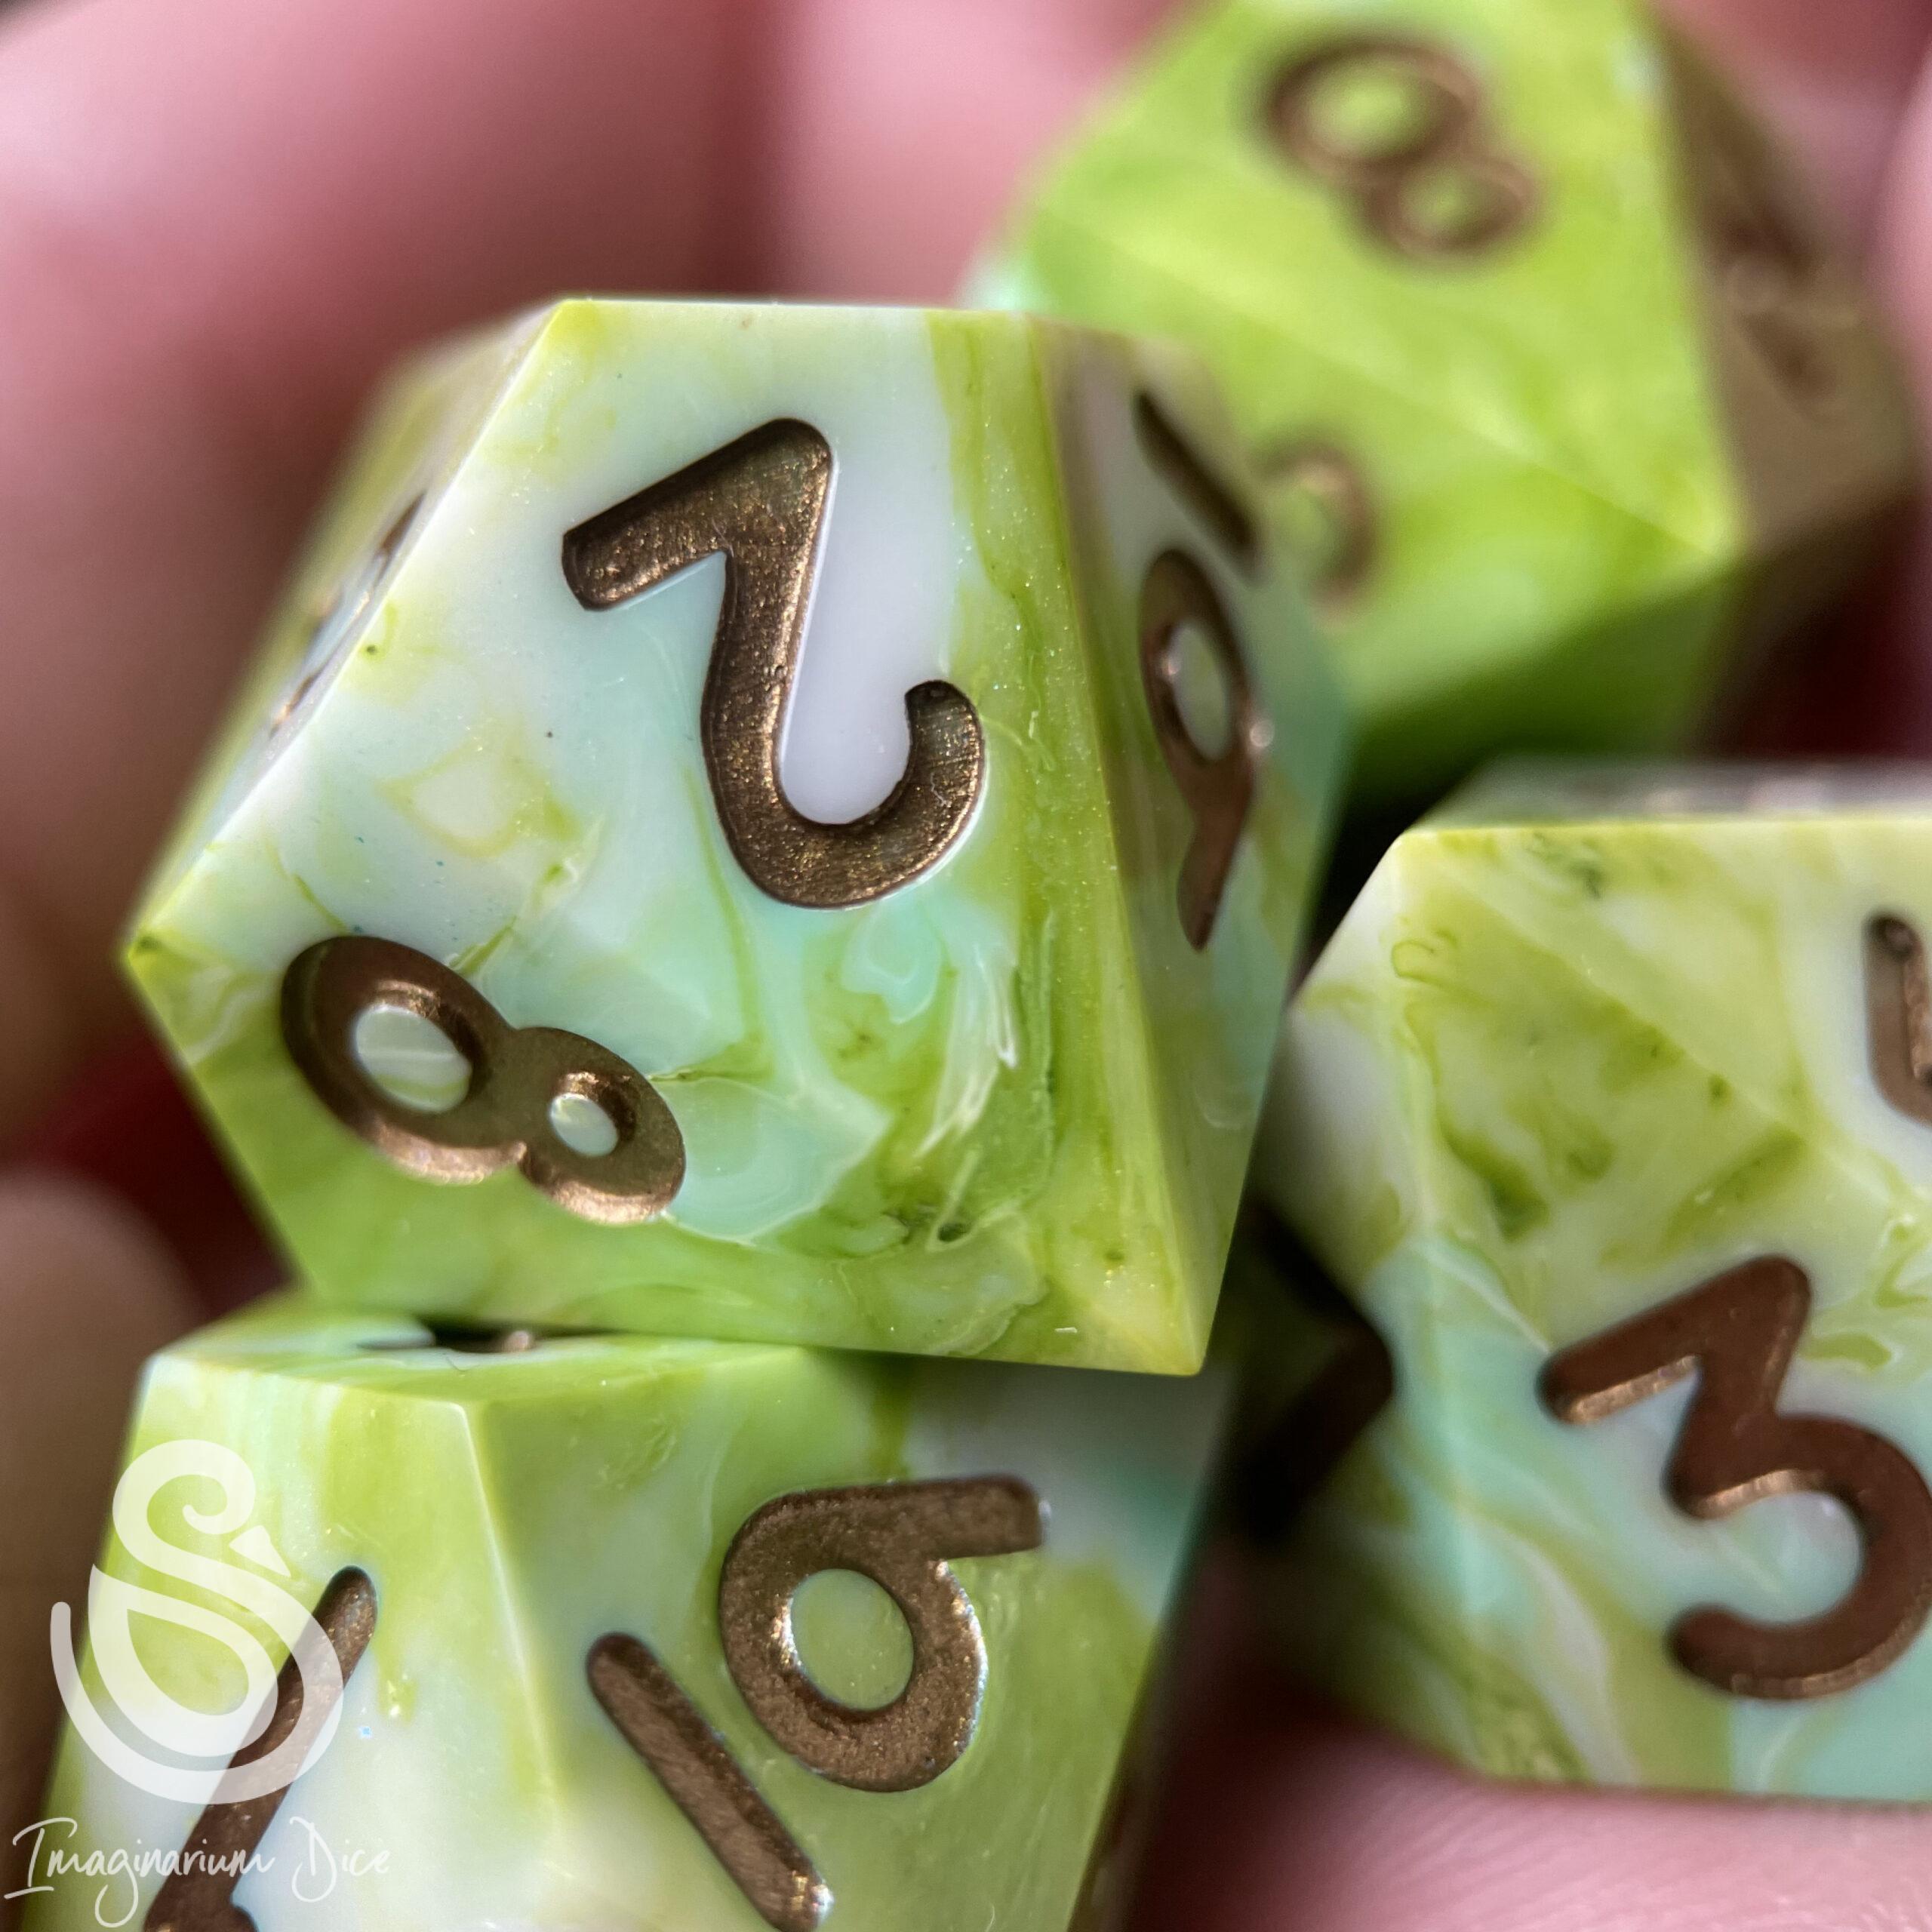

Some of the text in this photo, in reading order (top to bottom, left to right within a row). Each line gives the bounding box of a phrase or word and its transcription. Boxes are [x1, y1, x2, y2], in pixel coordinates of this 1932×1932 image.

[561, 417, 985, 909] 2
[281, 934, 685, 1225] 8
[1540, 1254, 1932, 1703] 3
